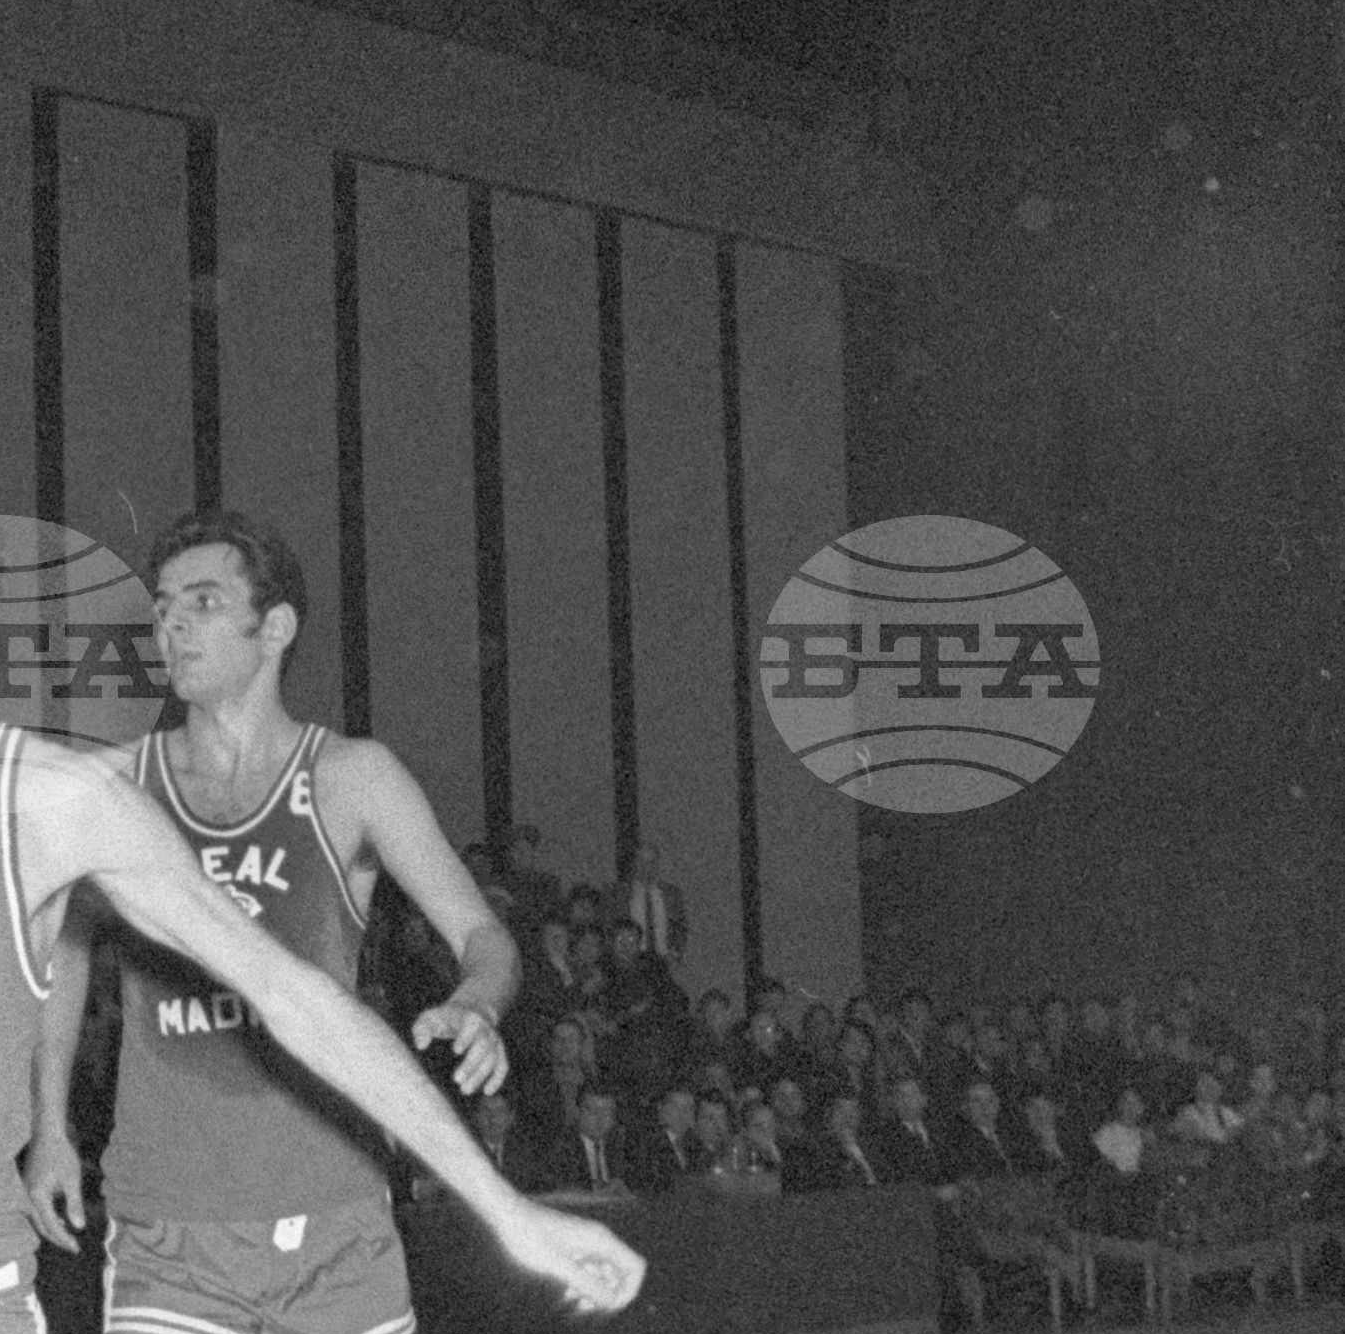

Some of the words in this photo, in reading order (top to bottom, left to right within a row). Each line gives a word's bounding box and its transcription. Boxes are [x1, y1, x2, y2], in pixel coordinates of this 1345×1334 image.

[289, 770, 311, 816] 6
[201, 845, 290, 892] EAL
[158, 992, 243, 1036] MAD
